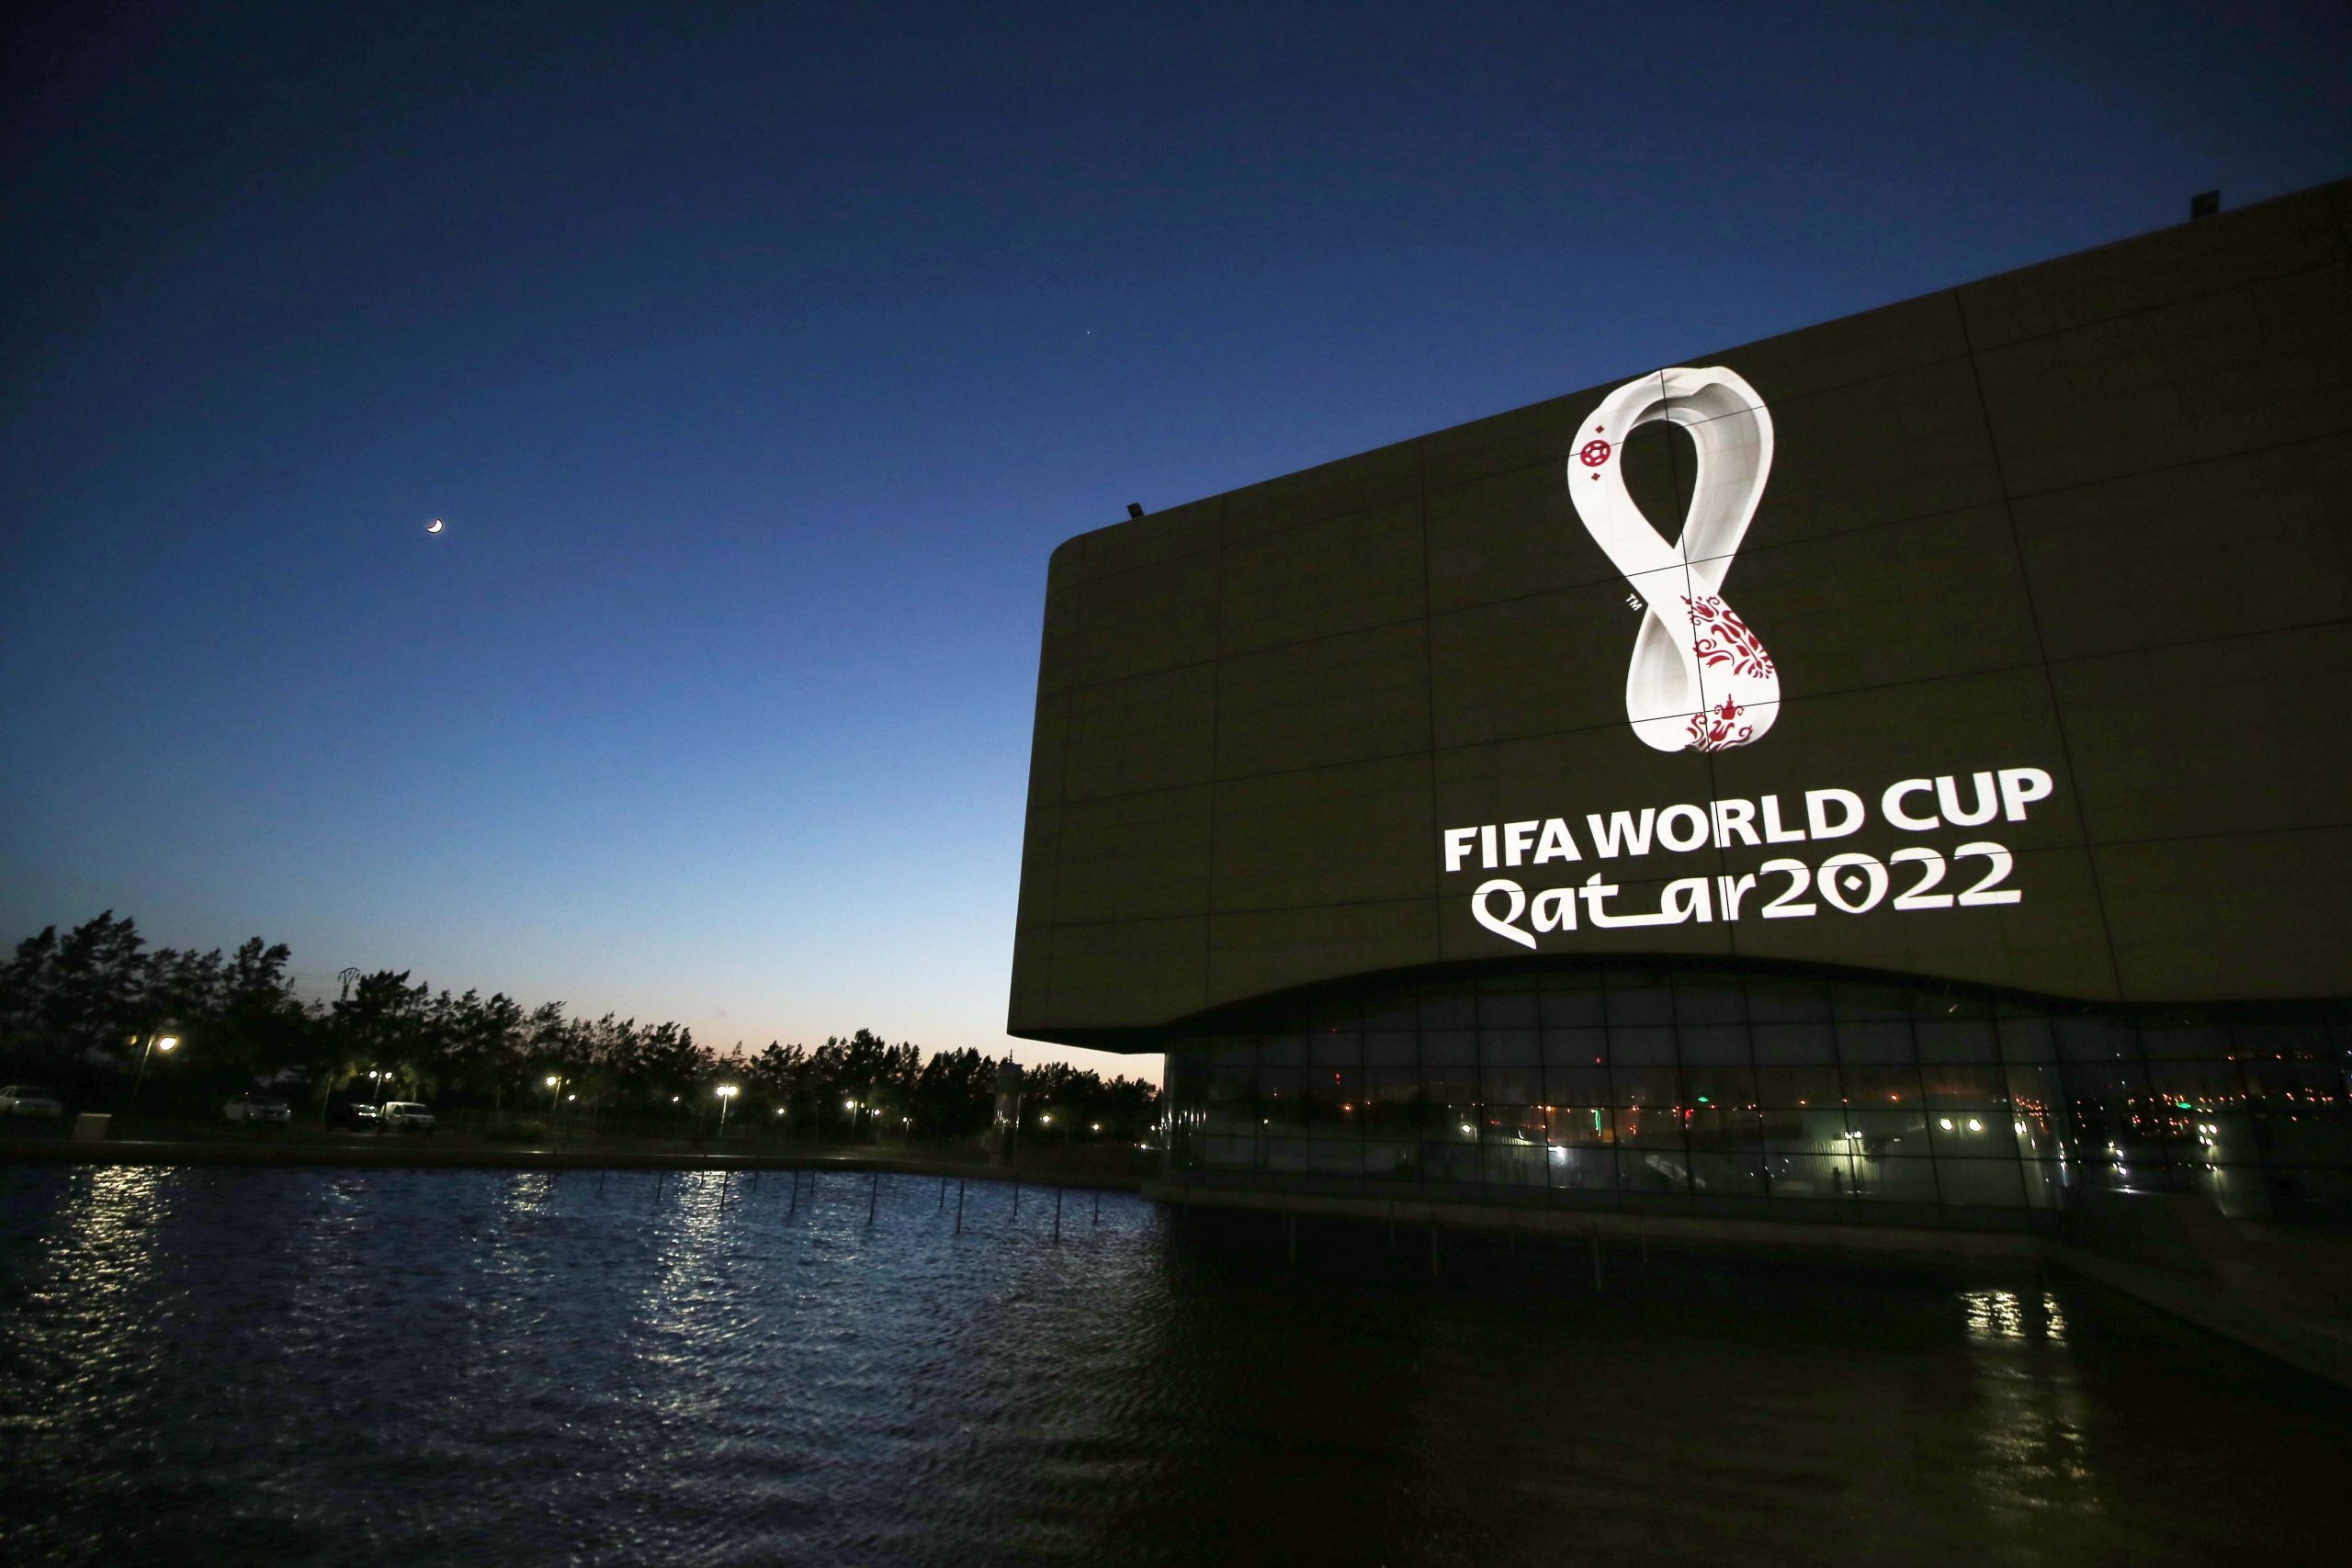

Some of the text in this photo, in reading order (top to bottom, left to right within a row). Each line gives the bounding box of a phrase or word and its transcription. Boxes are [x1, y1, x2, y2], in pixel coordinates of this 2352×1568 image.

[1625, 592, 1644, 612] TM
[1443, 767, 2053, 873] FIFA WORLD CUP
